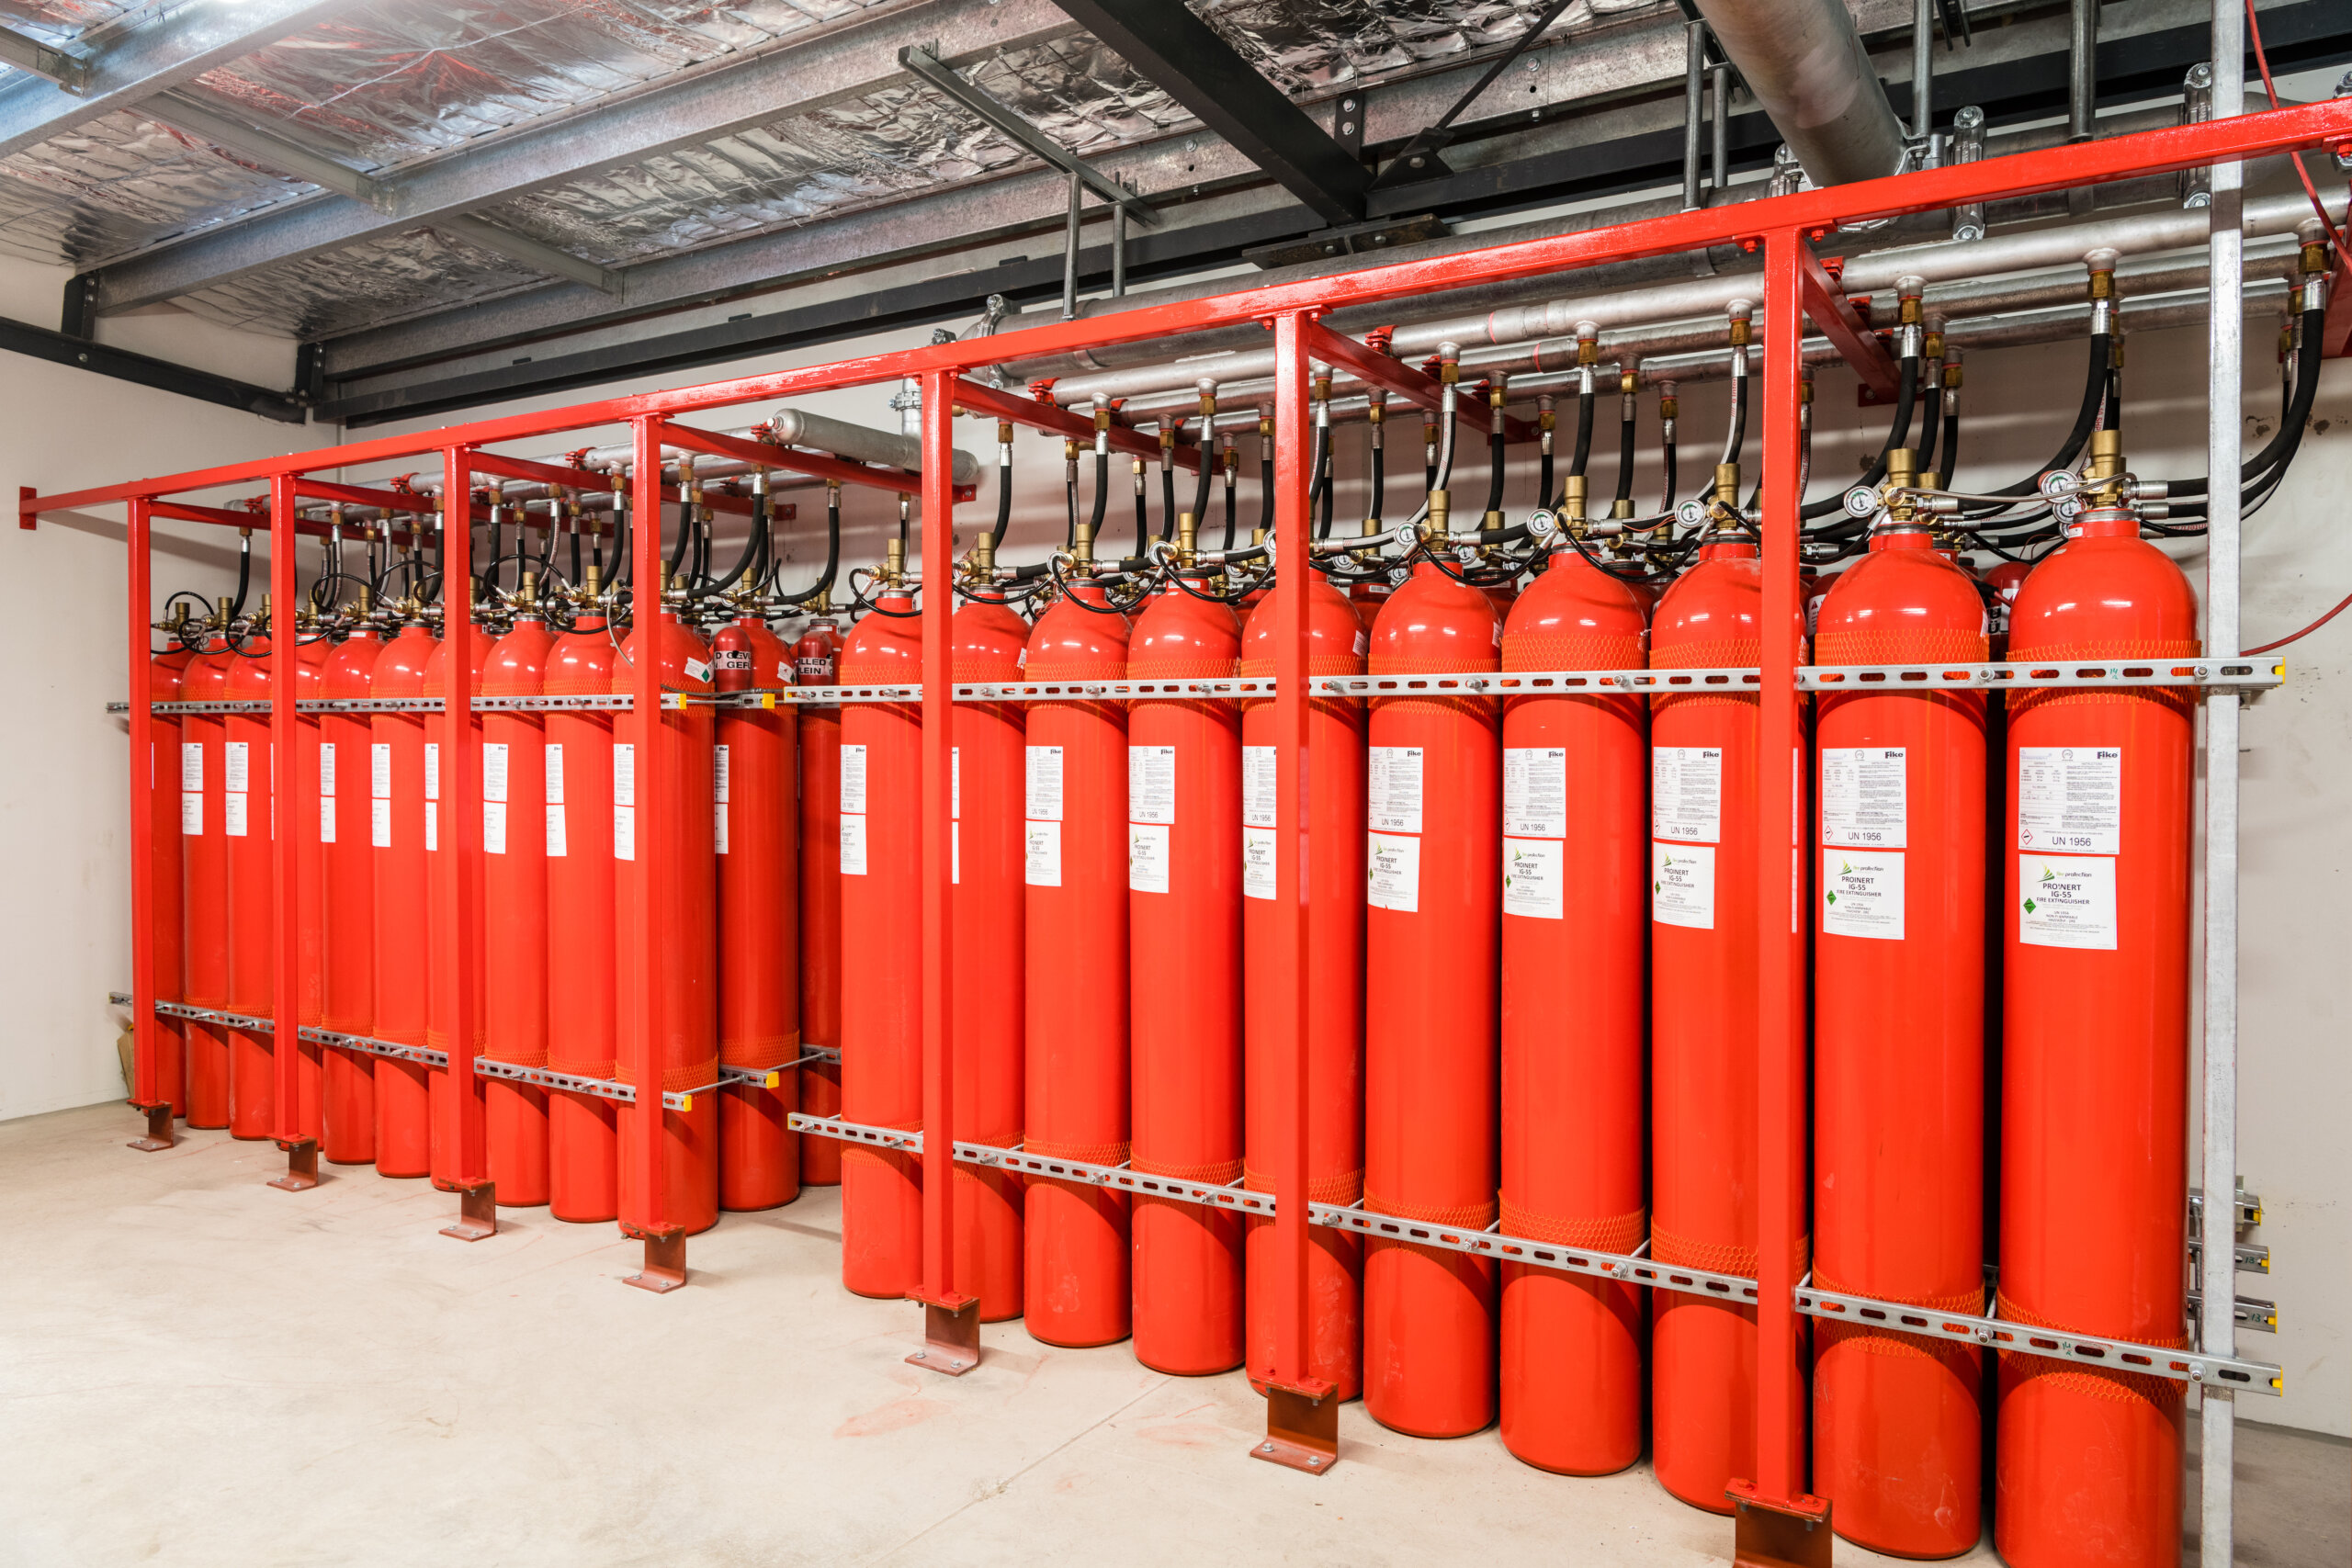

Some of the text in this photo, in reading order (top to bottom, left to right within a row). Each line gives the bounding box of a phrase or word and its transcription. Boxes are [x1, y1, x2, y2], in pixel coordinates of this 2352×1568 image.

[1548, 750, 1564, 759] Fike
[1702, 750, 1720, 759] Fike
[1884, 750, 1904, 759] Fike
[2097, 750, 2119, 760] Fike
[1381, 818, 1404, 827] UN 1956
[1520, 823, 1545, 832] UN 1956
[1670, 826, 1698, 836] UN 1956
[1848, 831, 1882, 841] UN 1956
[2052, 836, 2092, 847] UN 1956
[1841, 875, 1874, 884] PROINERT
[1849, 883, 1866, 891] IG-55
[2051, 890, 2072, 898] IG-55
